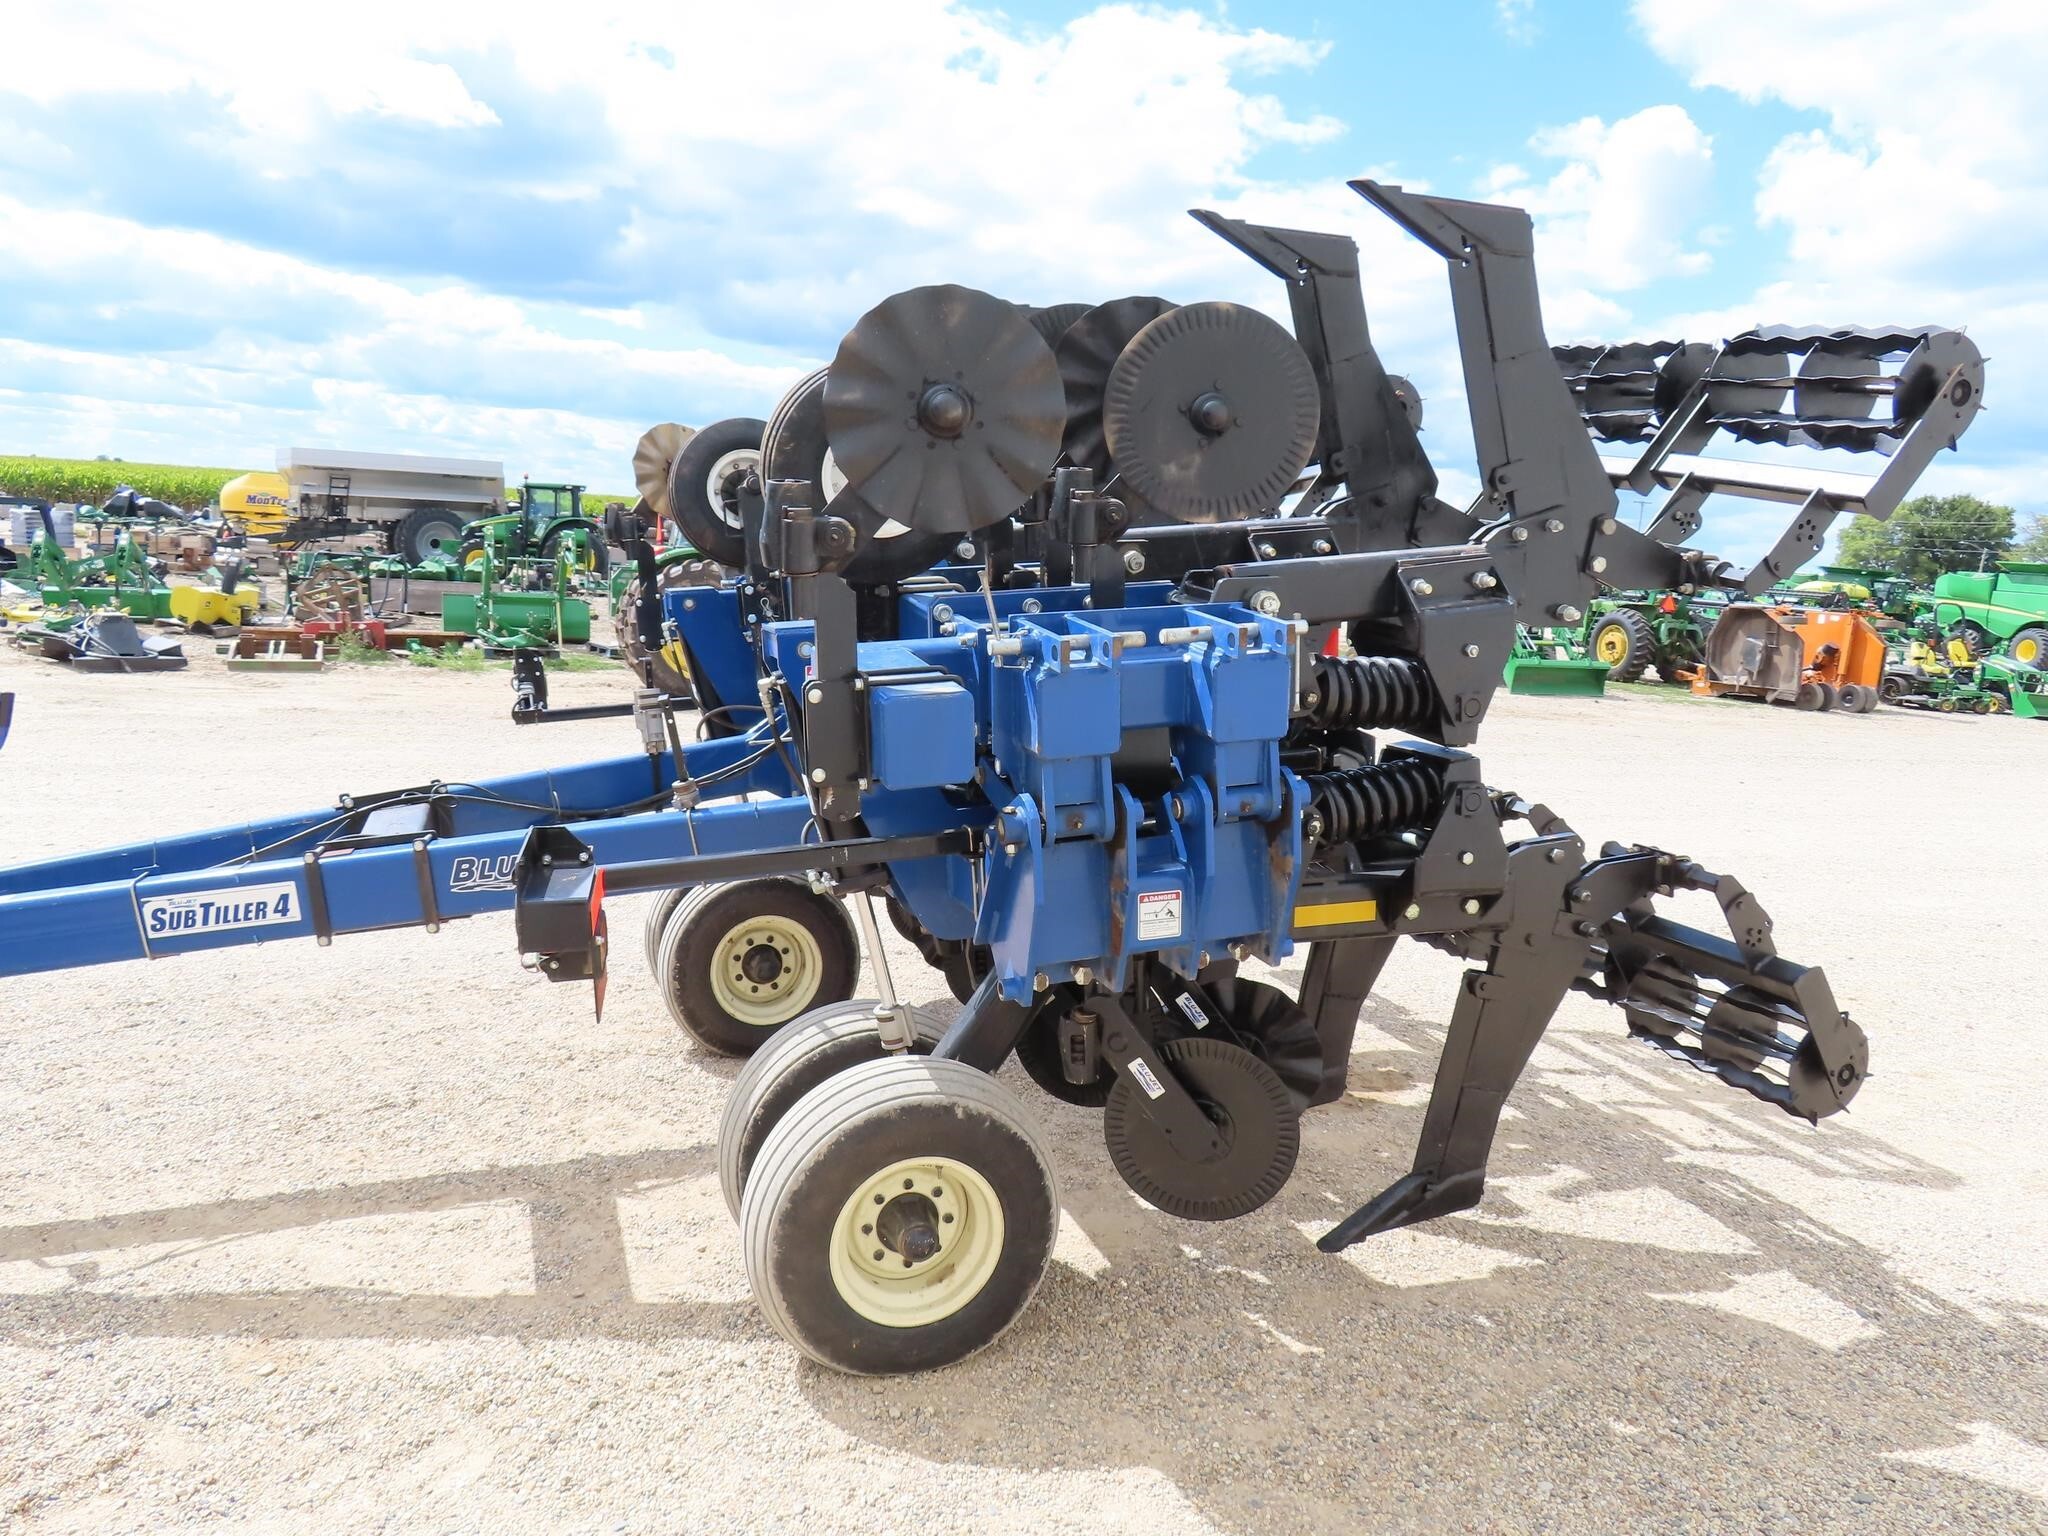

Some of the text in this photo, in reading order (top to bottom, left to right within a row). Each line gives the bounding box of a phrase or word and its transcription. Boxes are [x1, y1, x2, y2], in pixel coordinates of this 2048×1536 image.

[450, 855, 520, 886] BLU
[273, 893, 290, 917] 4
[1149, 893, 1177, 902] DANGER
